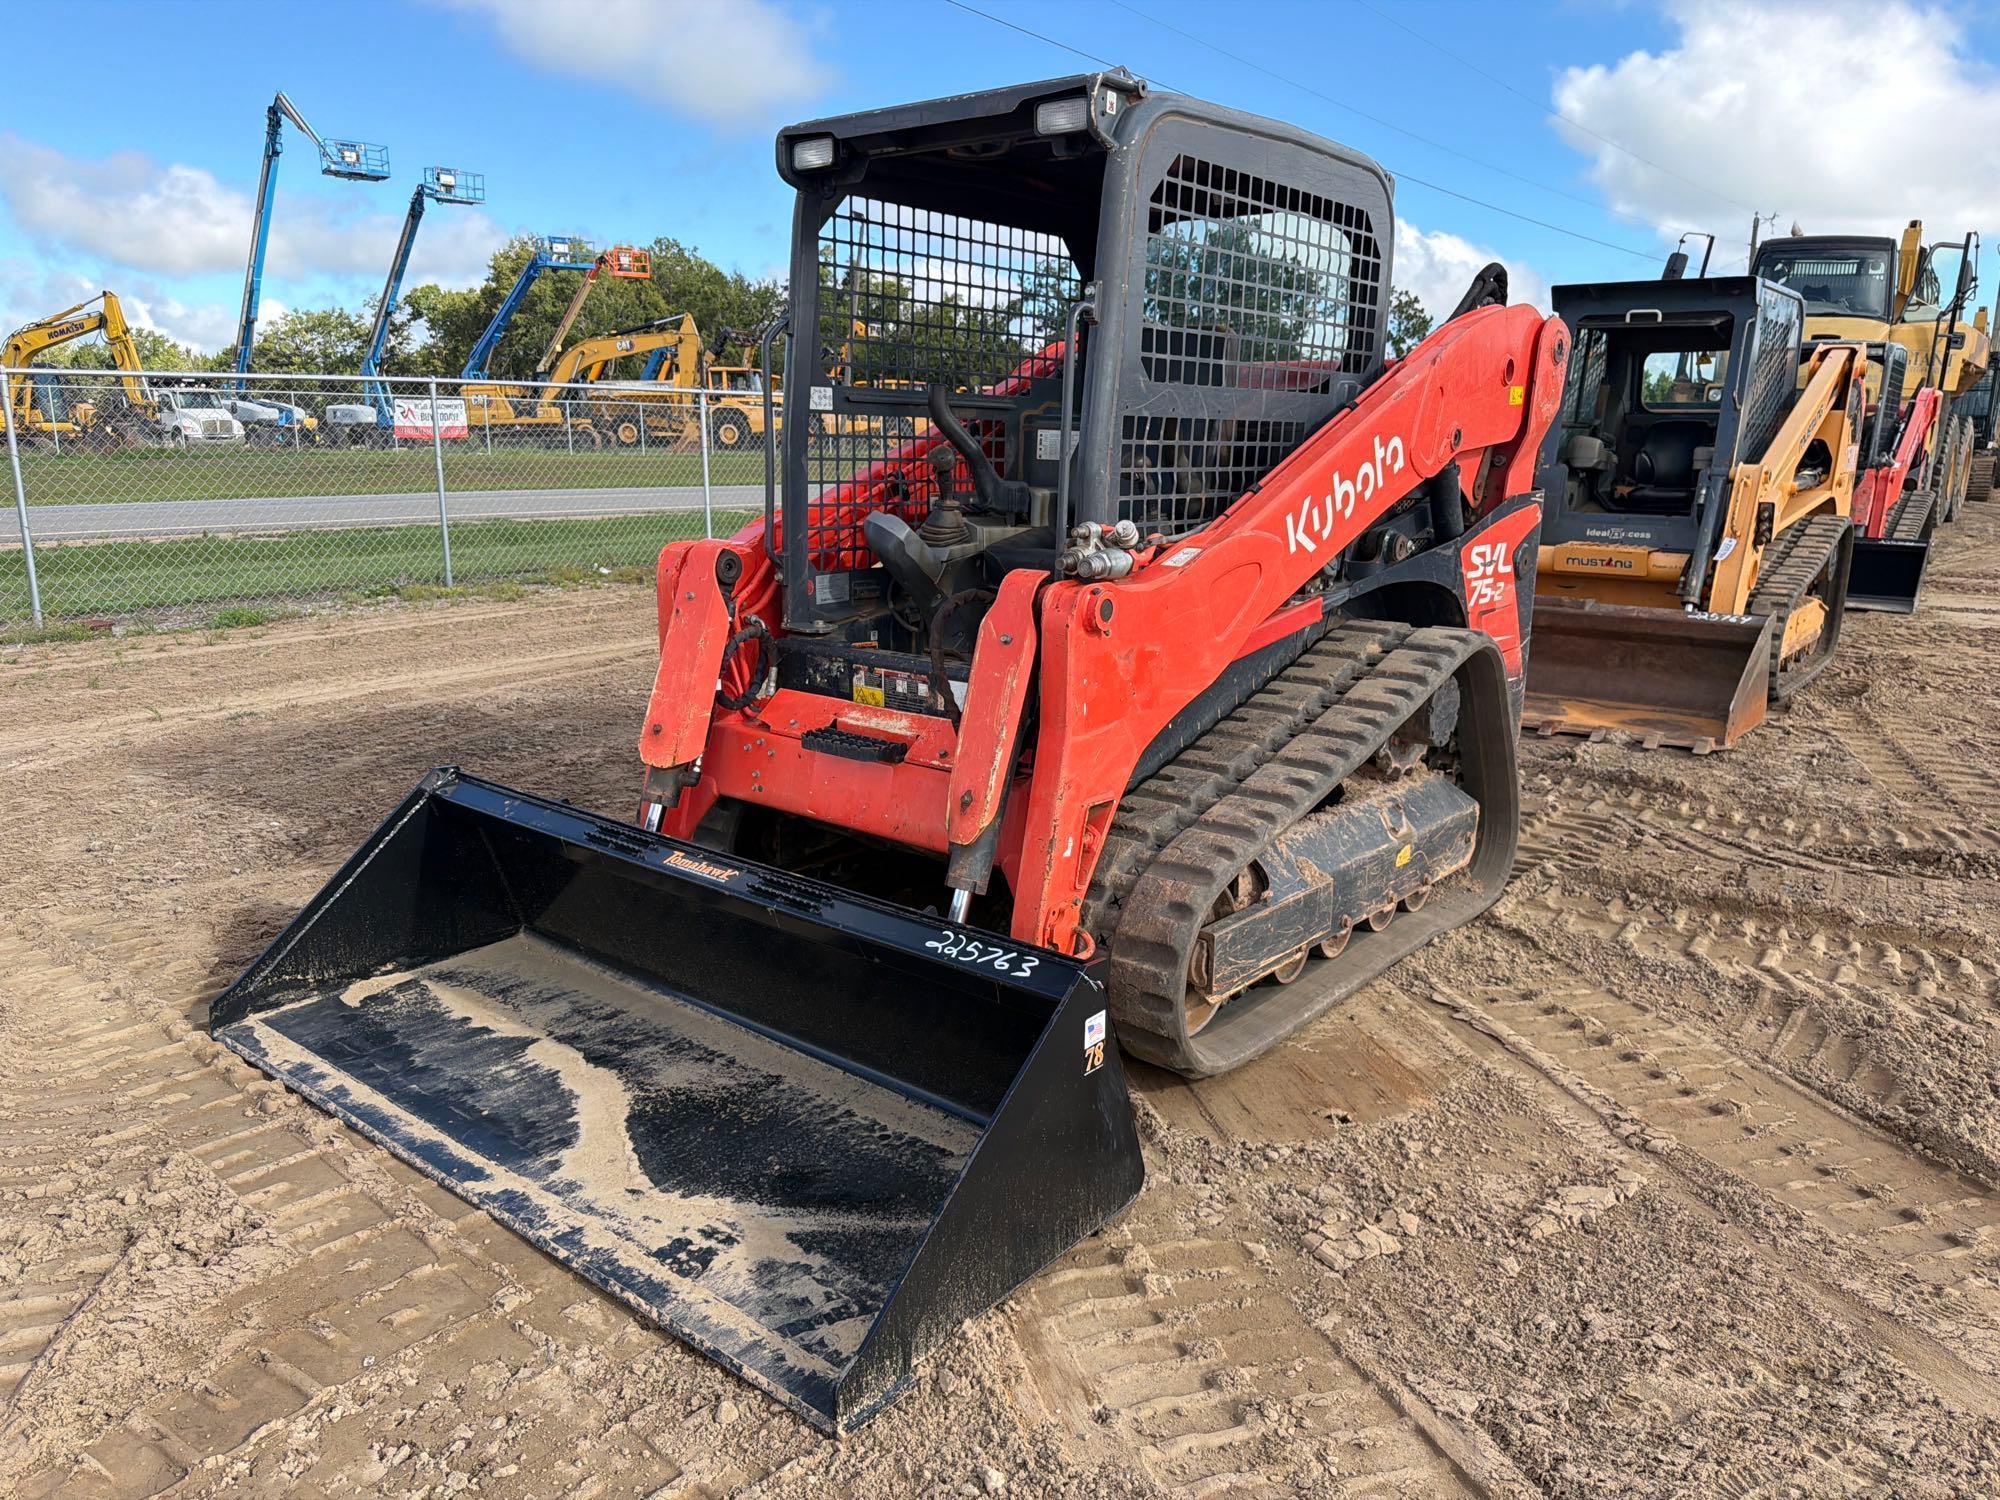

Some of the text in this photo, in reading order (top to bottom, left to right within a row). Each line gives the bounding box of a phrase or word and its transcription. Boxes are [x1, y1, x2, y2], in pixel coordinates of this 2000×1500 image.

[47, 322, 85, 340] KOMATSU
[616, 340, 632, 352] CAT
[1286, 434, 1405, 555] Kubota
[1466, 542, 1513, 579] SVL
[1468, 577, 1505, 608] 75-2
[662, 850, 739, 881] Tomahawk
[924, 930, 1040, 977] 225763
